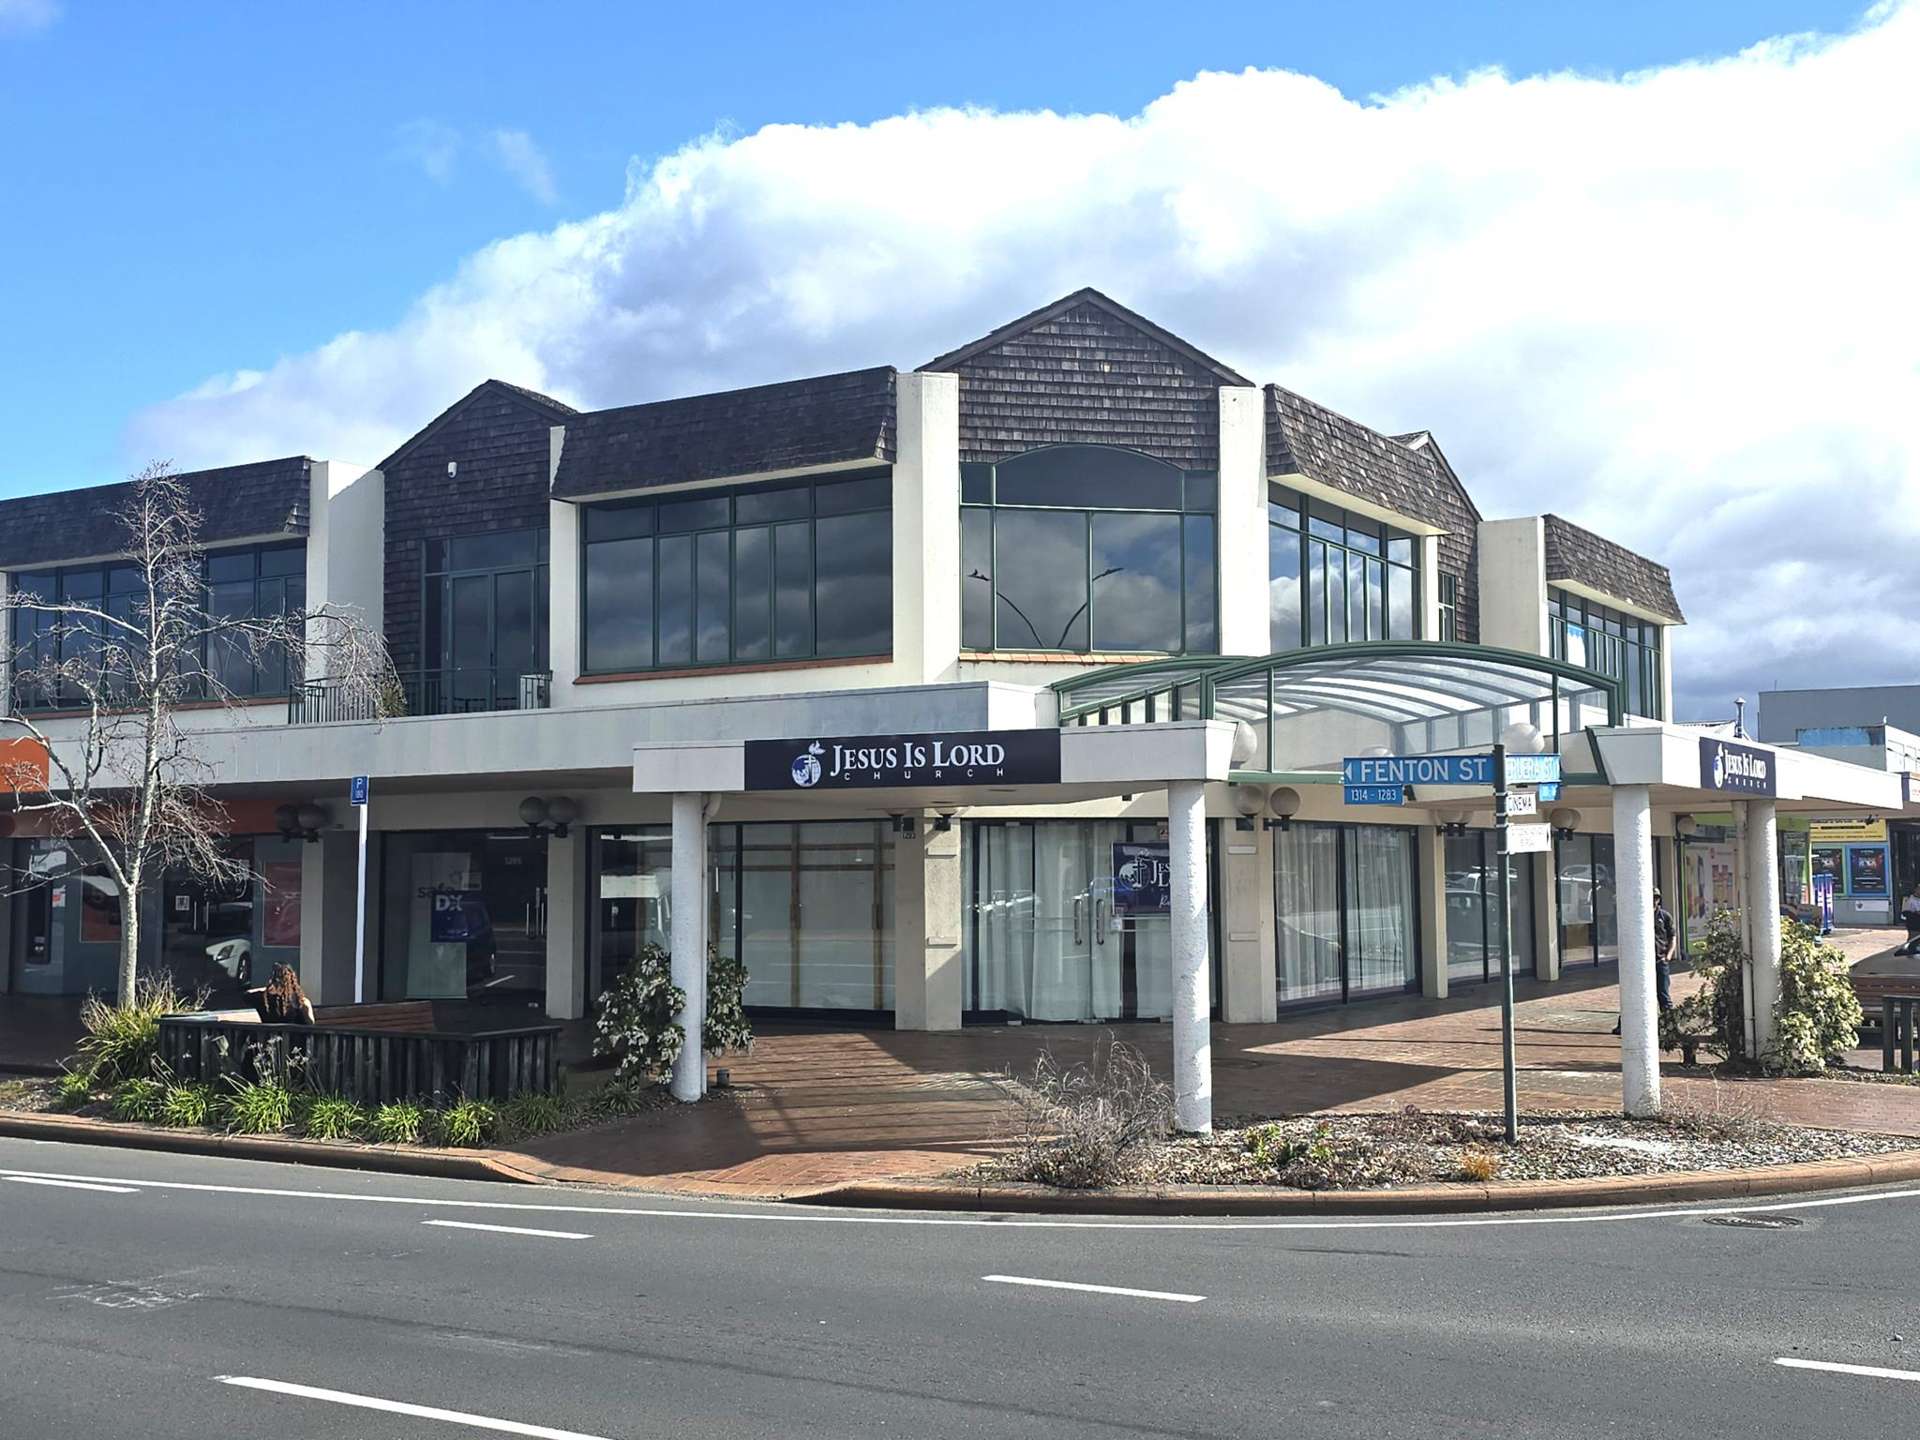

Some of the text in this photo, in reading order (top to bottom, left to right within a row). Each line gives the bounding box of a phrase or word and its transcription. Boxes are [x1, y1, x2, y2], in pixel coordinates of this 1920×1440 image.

[830, 741, 1005, 777] JESUS IS LORD
[1724, 749, 1766, 779] JESUS IS LORD
[844, 769, 1004, 781] CHURCH
[1361, 758, 1487, 782] FENTON ST
[356, 777, 363, 789] P
[1351, 789, 1368, 800] 1314
[1378, 788, 1396, 800] 1283
[1150, 860, 1170, 884] JES
[435, 894, 463, 911] DX
